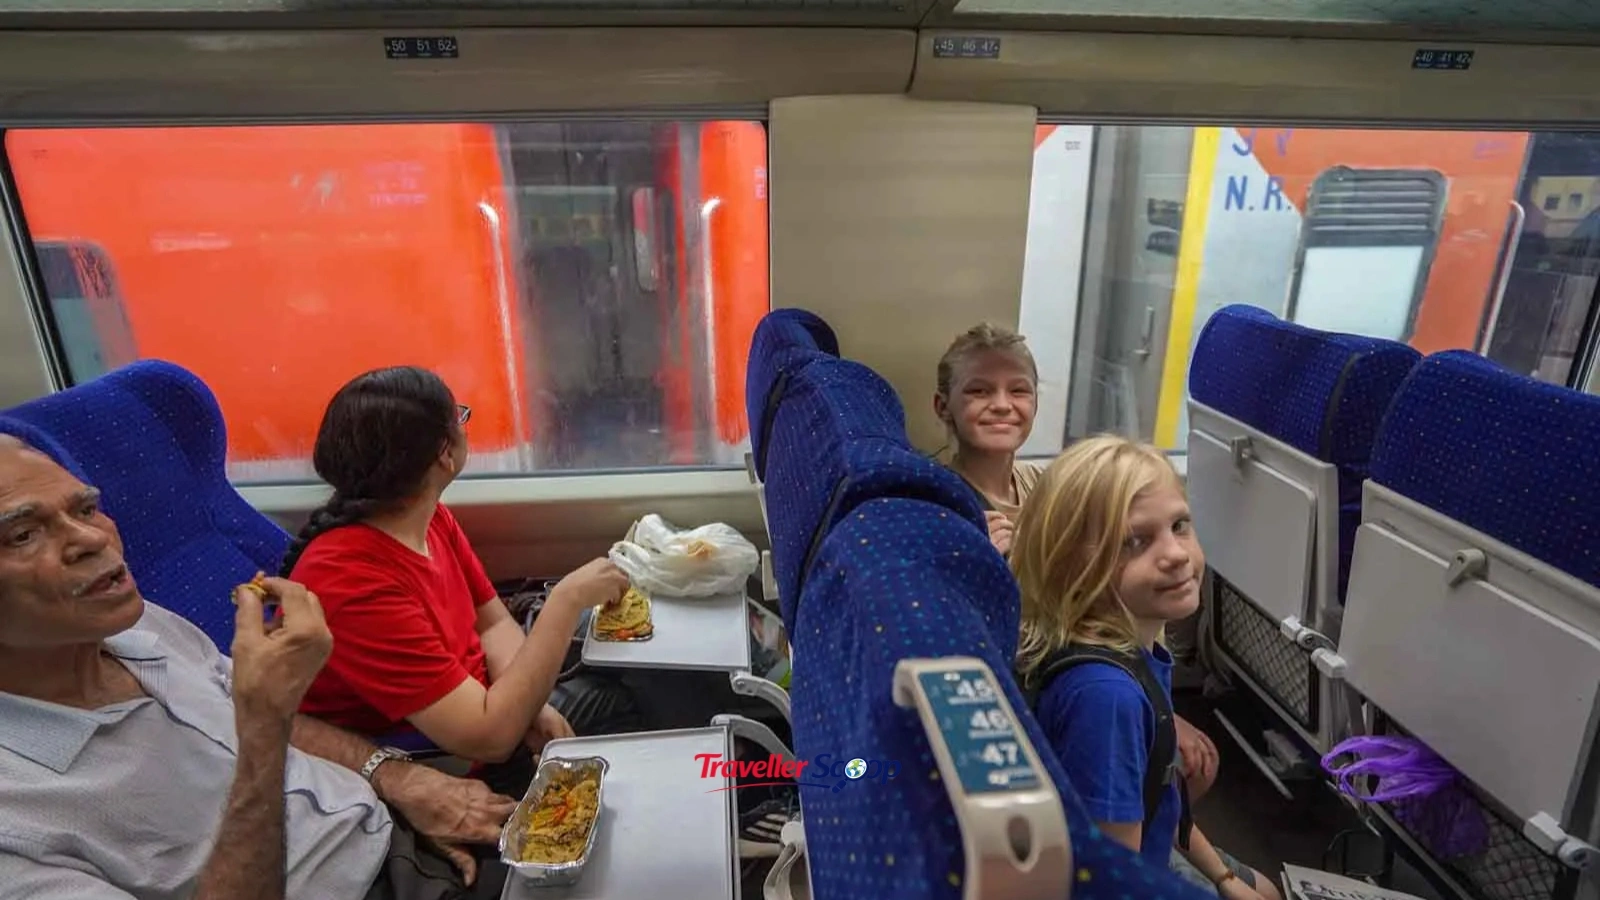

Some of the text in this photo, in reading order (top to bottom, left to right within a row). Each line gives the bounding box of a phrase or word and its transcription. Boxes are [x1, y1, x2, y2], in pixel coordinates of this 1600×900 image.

[391, 39, 453, 52] 50 51 52
[940, 40, 954, 51] 45
[956, 678, 995, 699] 45
[970, 708, 1010, 730] 46
[983, 742, 1018, 766] 47
